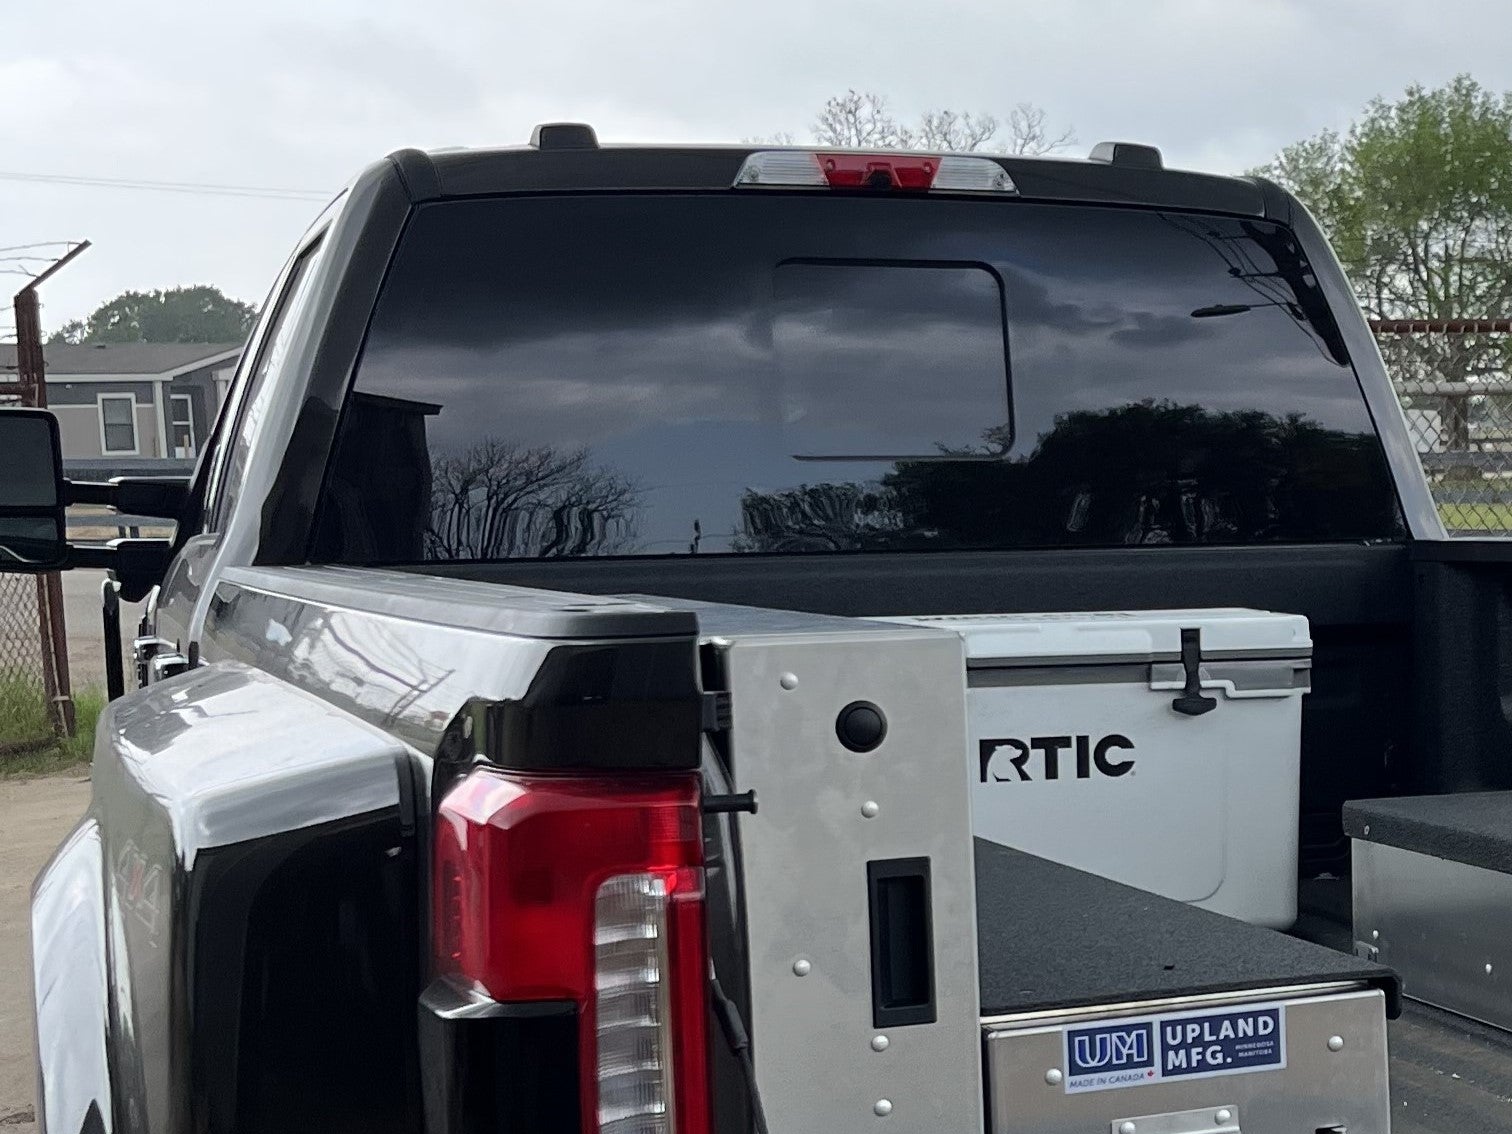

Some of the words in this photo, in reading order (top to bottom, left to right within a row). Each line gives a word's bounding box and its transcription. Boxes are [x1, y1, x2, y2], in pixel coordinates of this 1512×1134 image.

[979, 734, 1136, 783] RTIC
[1165, 1015, 1275, 1046] UPLAND
[1166, 1045, 1233, 1071] MFG.
[1069, 1078, 1095, 1089] MADE
[1097, 1077, 1107, 1086] IN
[1108, 1073, 1145, 1085] CANADA
